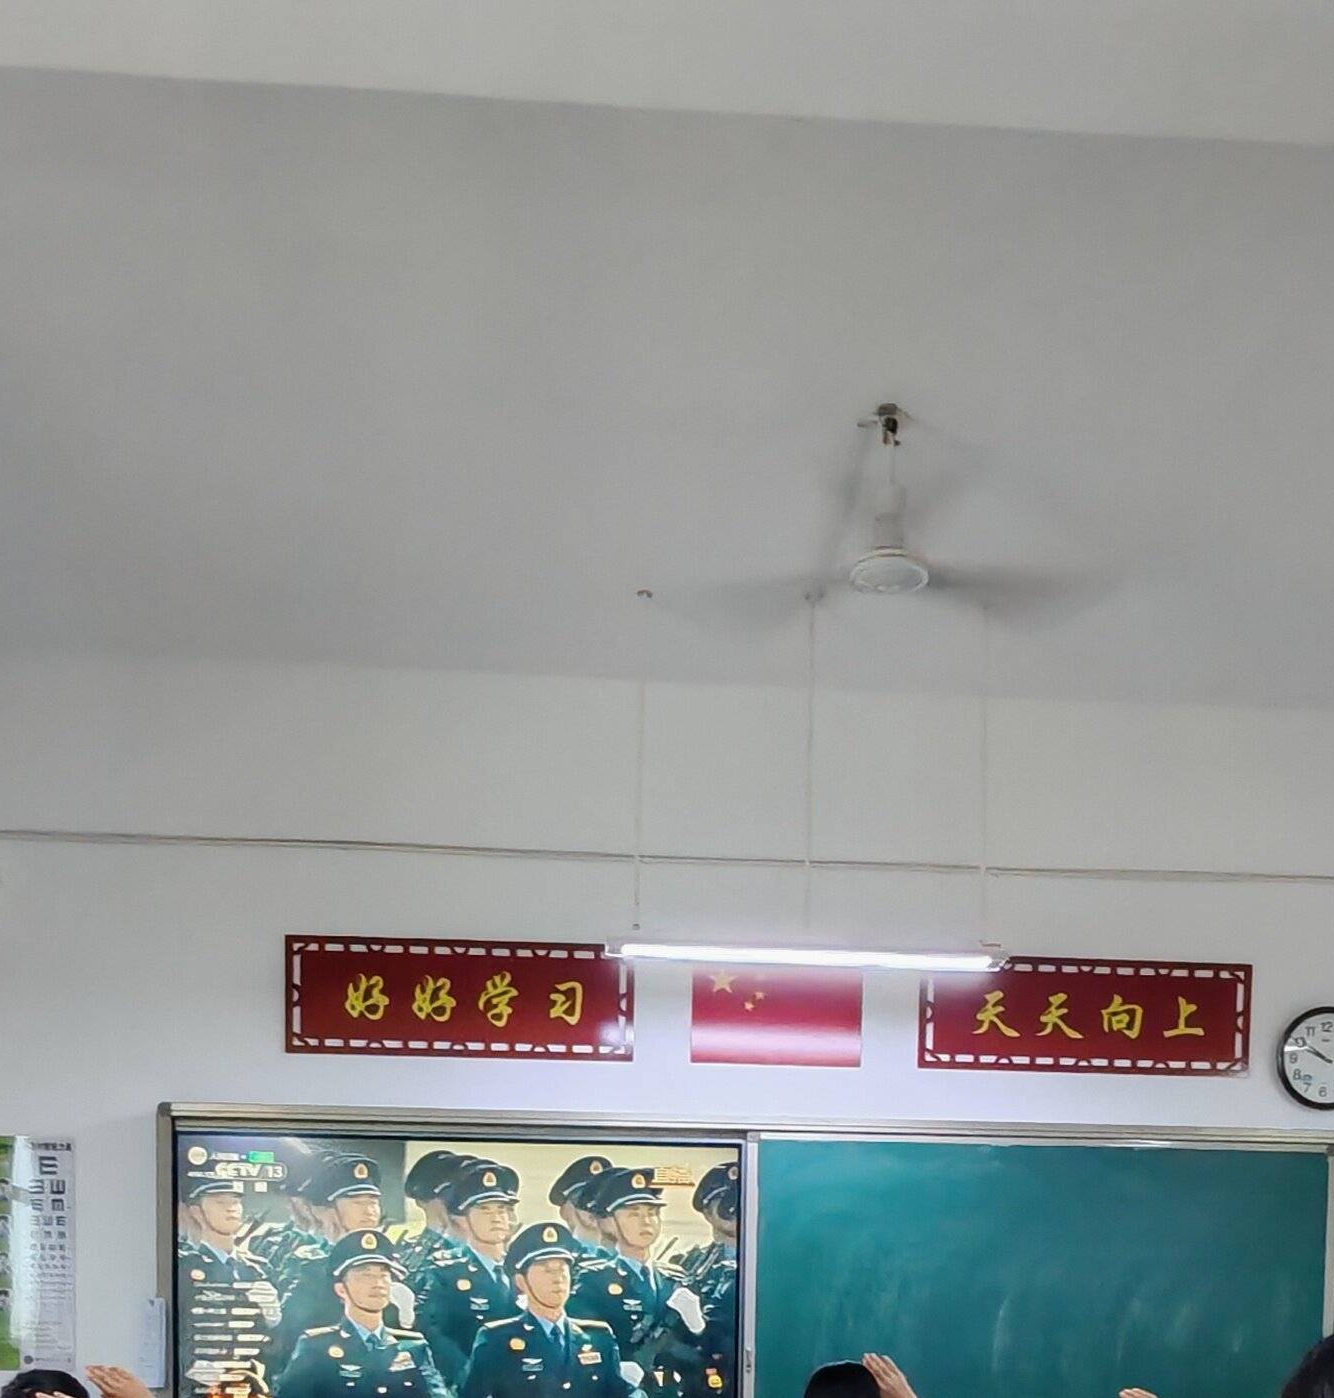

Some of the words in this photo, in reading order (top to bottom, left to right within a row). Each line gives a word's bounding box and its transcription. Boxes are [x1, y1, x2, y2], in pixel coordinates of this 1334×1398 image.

[344, 970, 585, 1028] 好好学习
[971, 989, 1207, 1040] 天天向上
[1306, 1026, 1316, 1037] 11
[1321, 1021, 1333, 1033] 12
[1290, 1053, 1298, 1064] 9
[1319, 1086, 1327, 1097] 6
